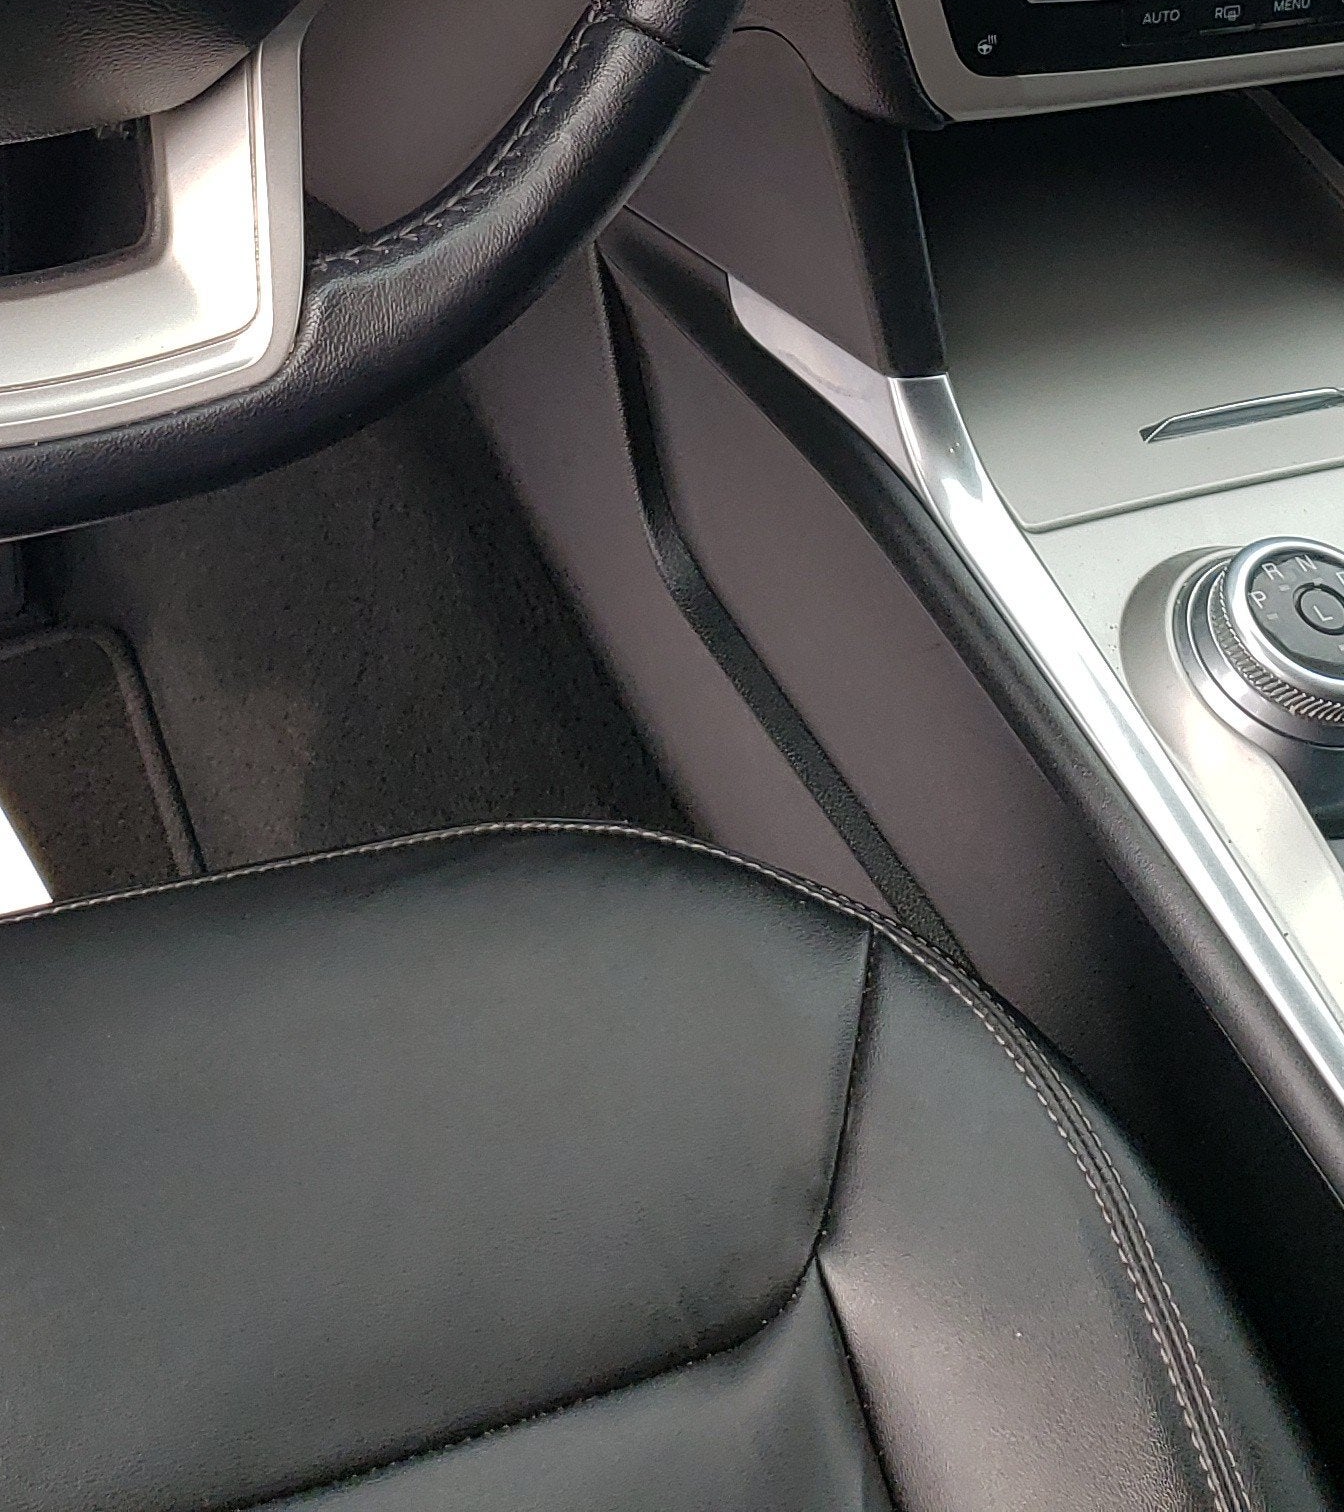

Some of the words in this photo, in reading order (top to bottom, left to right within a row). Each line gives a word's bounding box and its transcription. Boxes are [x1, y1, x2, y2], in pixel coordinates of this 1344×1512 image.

[1142, 9, 1180, 26] AUTO
[1261, 562, 1284, 581] R
[1296, 554, 1318, 572] N
[1248, 590, 1268, 609] P
[1312, 605, 1334, 623] L
